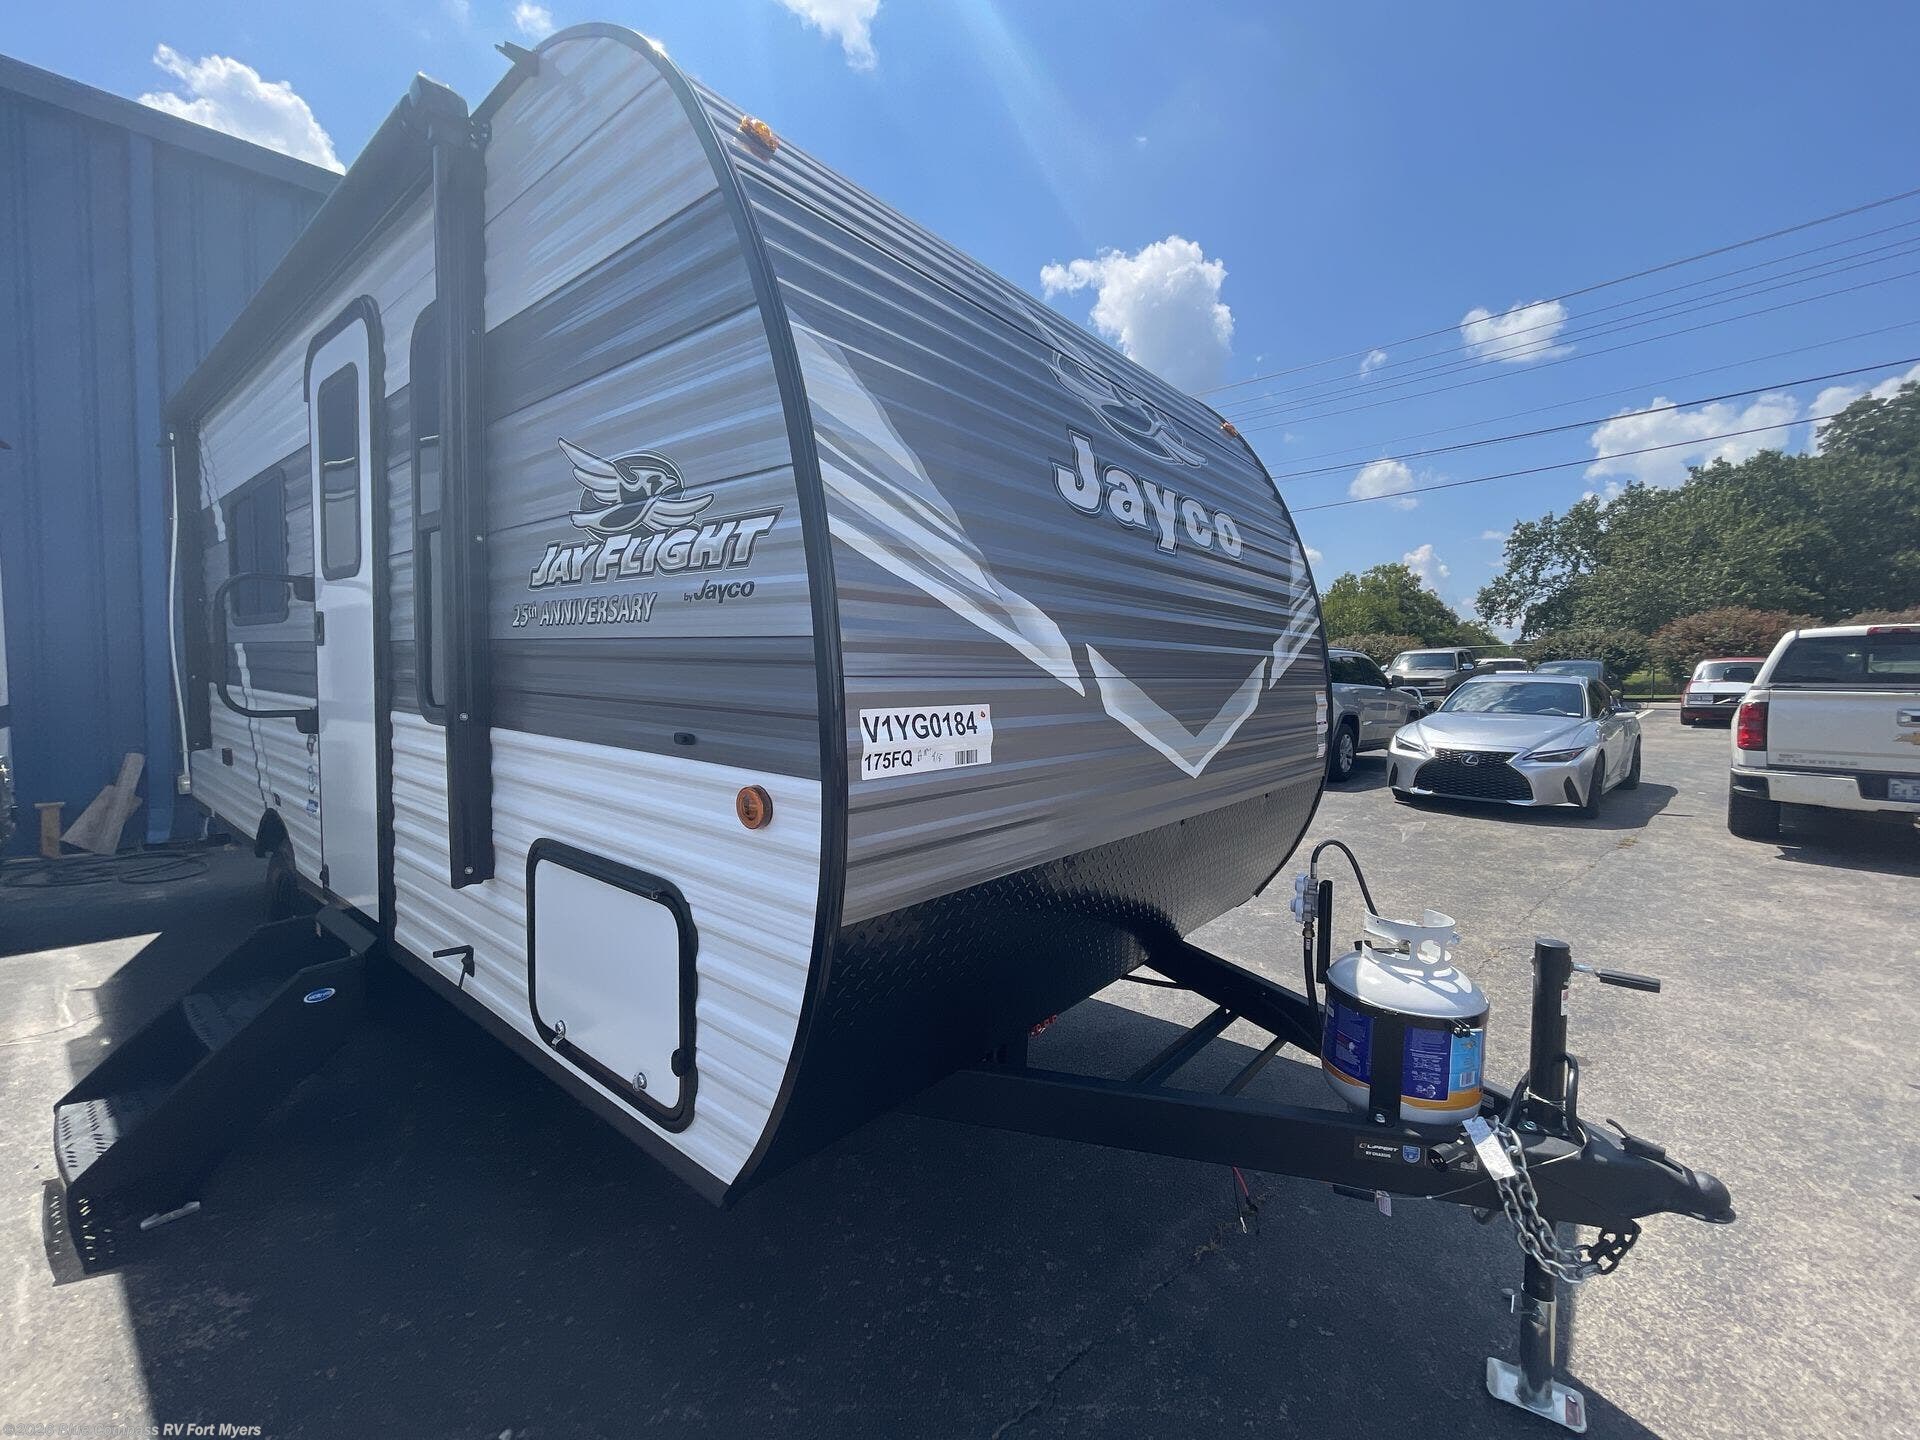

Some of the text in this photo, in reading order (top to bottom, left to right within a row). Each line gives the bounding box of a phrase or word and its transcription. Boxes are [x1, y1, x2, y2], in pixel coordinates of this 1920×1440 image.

[1050, 426, 1244, 560] Jayco
[683, 579, 755, 604] by Jayco
[512, 592, 658, 628] 25th ANNIVERSARY
[862, 711, 978, 743] V1YG0184
[864, 749, 913, 772] 175FQ
